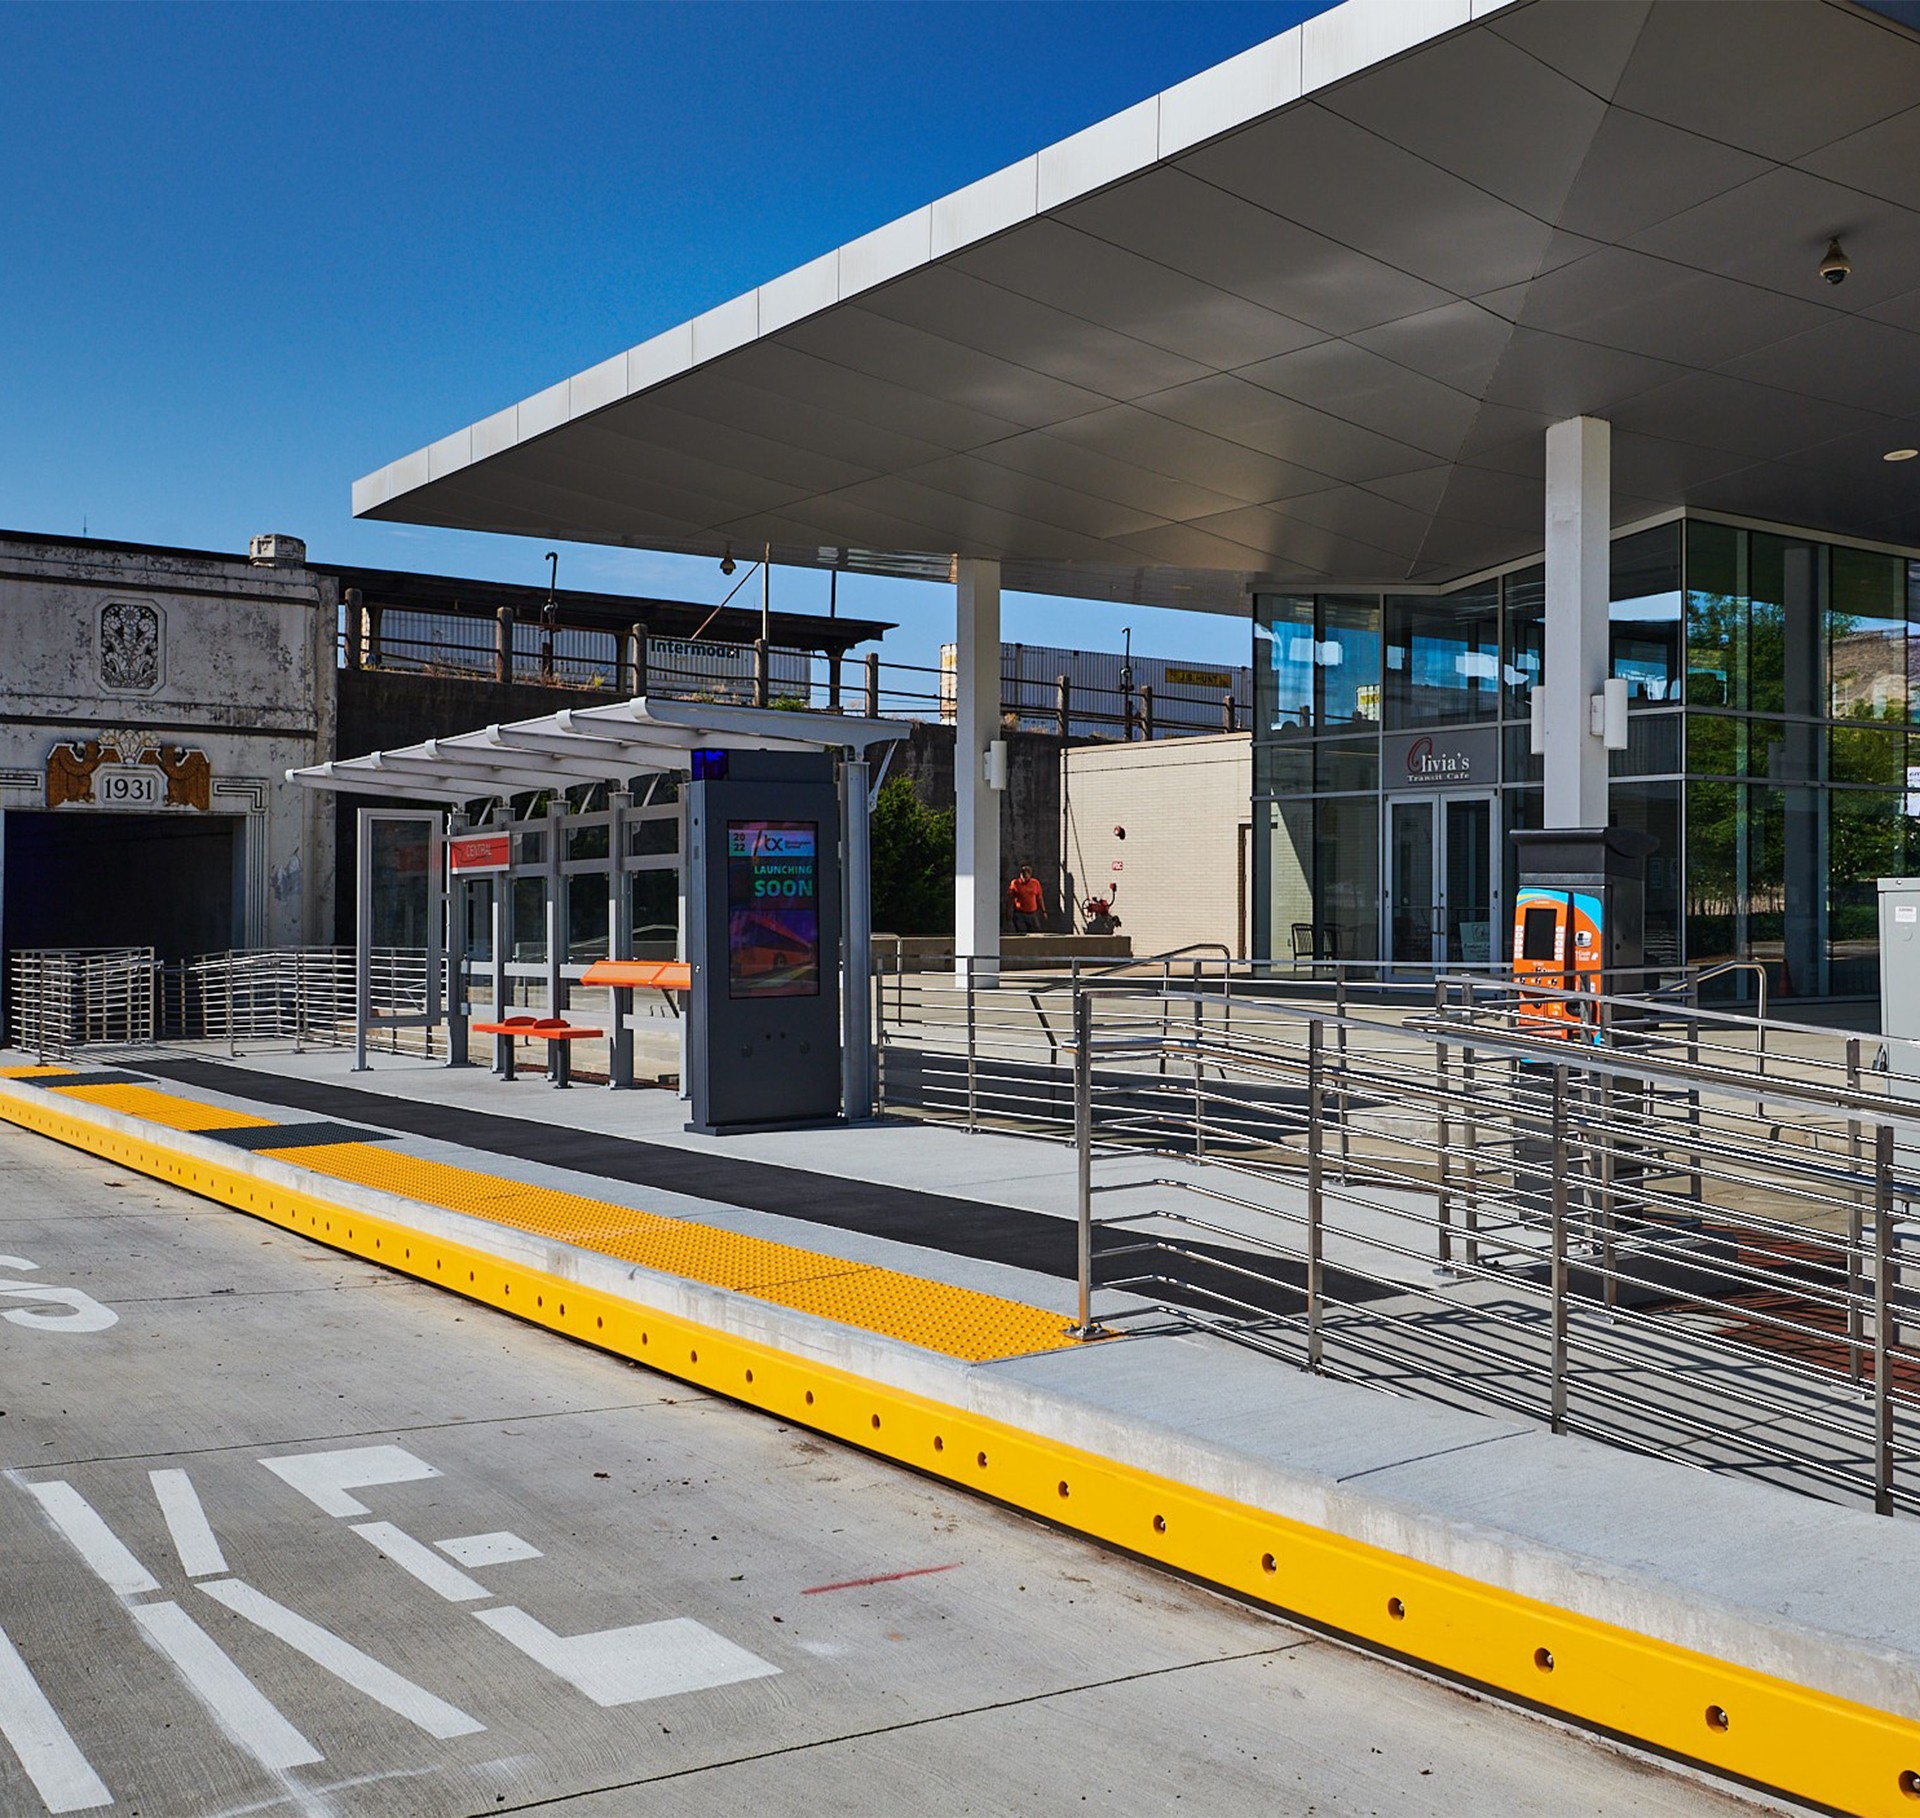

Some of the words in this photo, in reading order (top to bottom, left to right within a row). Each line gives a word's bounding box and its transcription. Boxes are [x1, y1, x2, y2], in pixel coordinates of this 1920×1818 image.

[651, 640, 739, 659] Intermodal
[1407, 737, 1470, 773] Olivia's
[1407, 774, 1442, 782] Transit
[1446, 772, 1470, 780] Cafe
[105, 778, 152, 800] 1931
[733, 833, 746, 842] 20
[733, 843, 746, 852] 22
[754, 865, 813, 875] LAUNCHING
[754, 880, 813, 897] SOON
